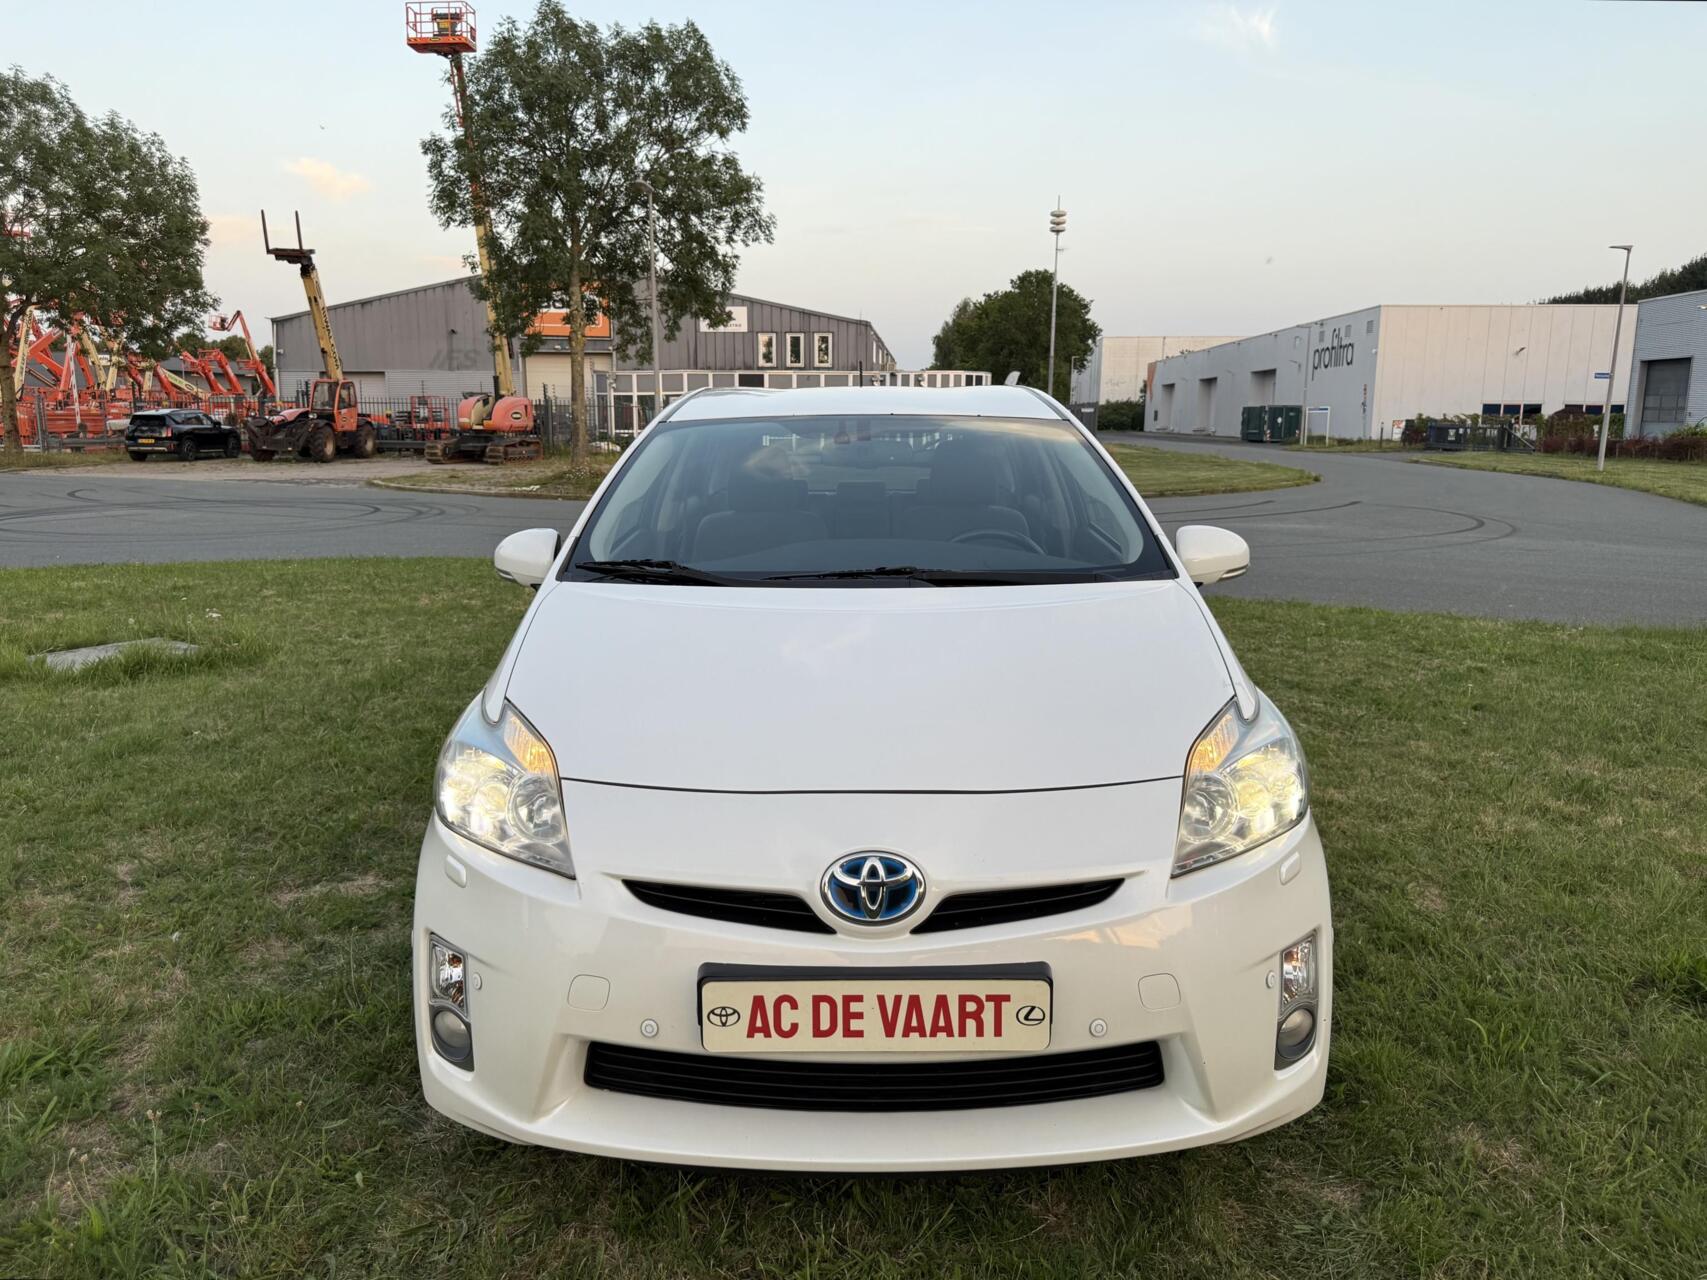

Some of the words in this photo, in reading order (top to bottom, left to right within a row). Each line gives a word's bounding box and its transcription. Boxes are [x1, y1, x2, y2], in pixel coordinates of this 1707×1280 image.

[1311, 327, 1354, 381] profiltra
[746, 994, 799, 1039] AC
[812, 994, 864, 1038] DE
[876, 994, 1011, 1038] VAART
